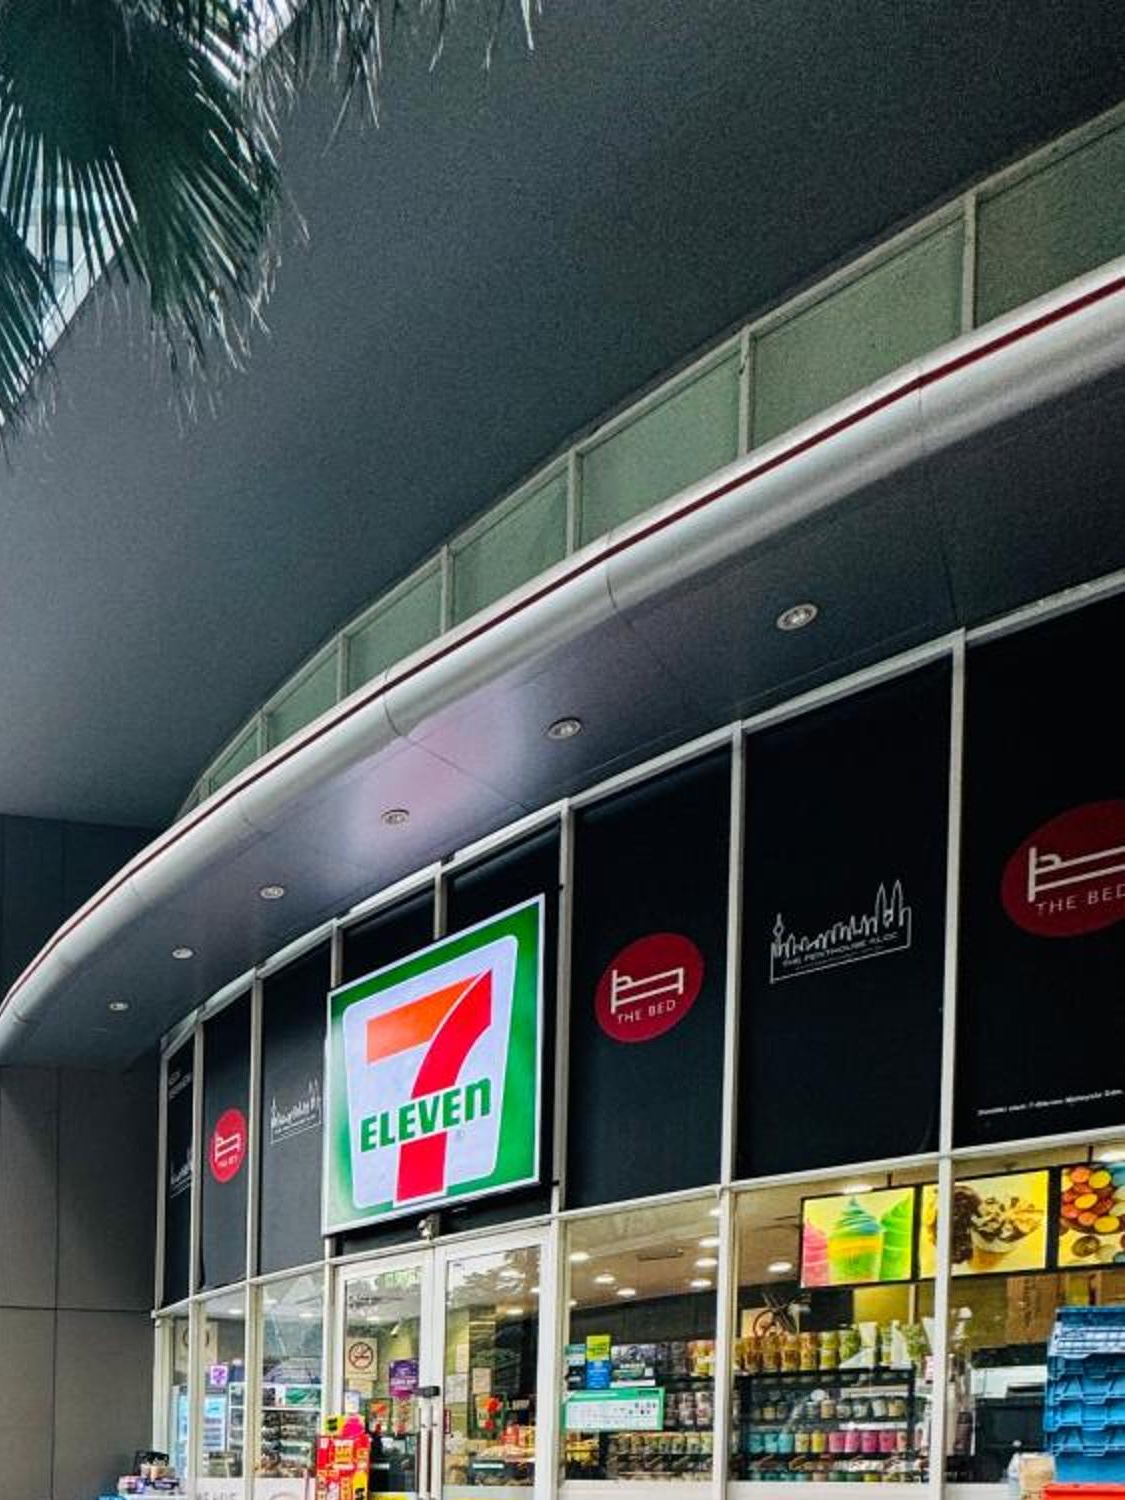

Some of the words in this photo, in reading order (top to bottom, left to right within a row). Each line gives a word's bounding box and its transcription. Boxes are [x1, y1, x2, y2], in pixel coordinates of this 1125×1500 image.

[1035, 893, 1078, 917] THE
[617, 1009, 642, 1024] THE
[648, 1000, 676, 1017] BED
